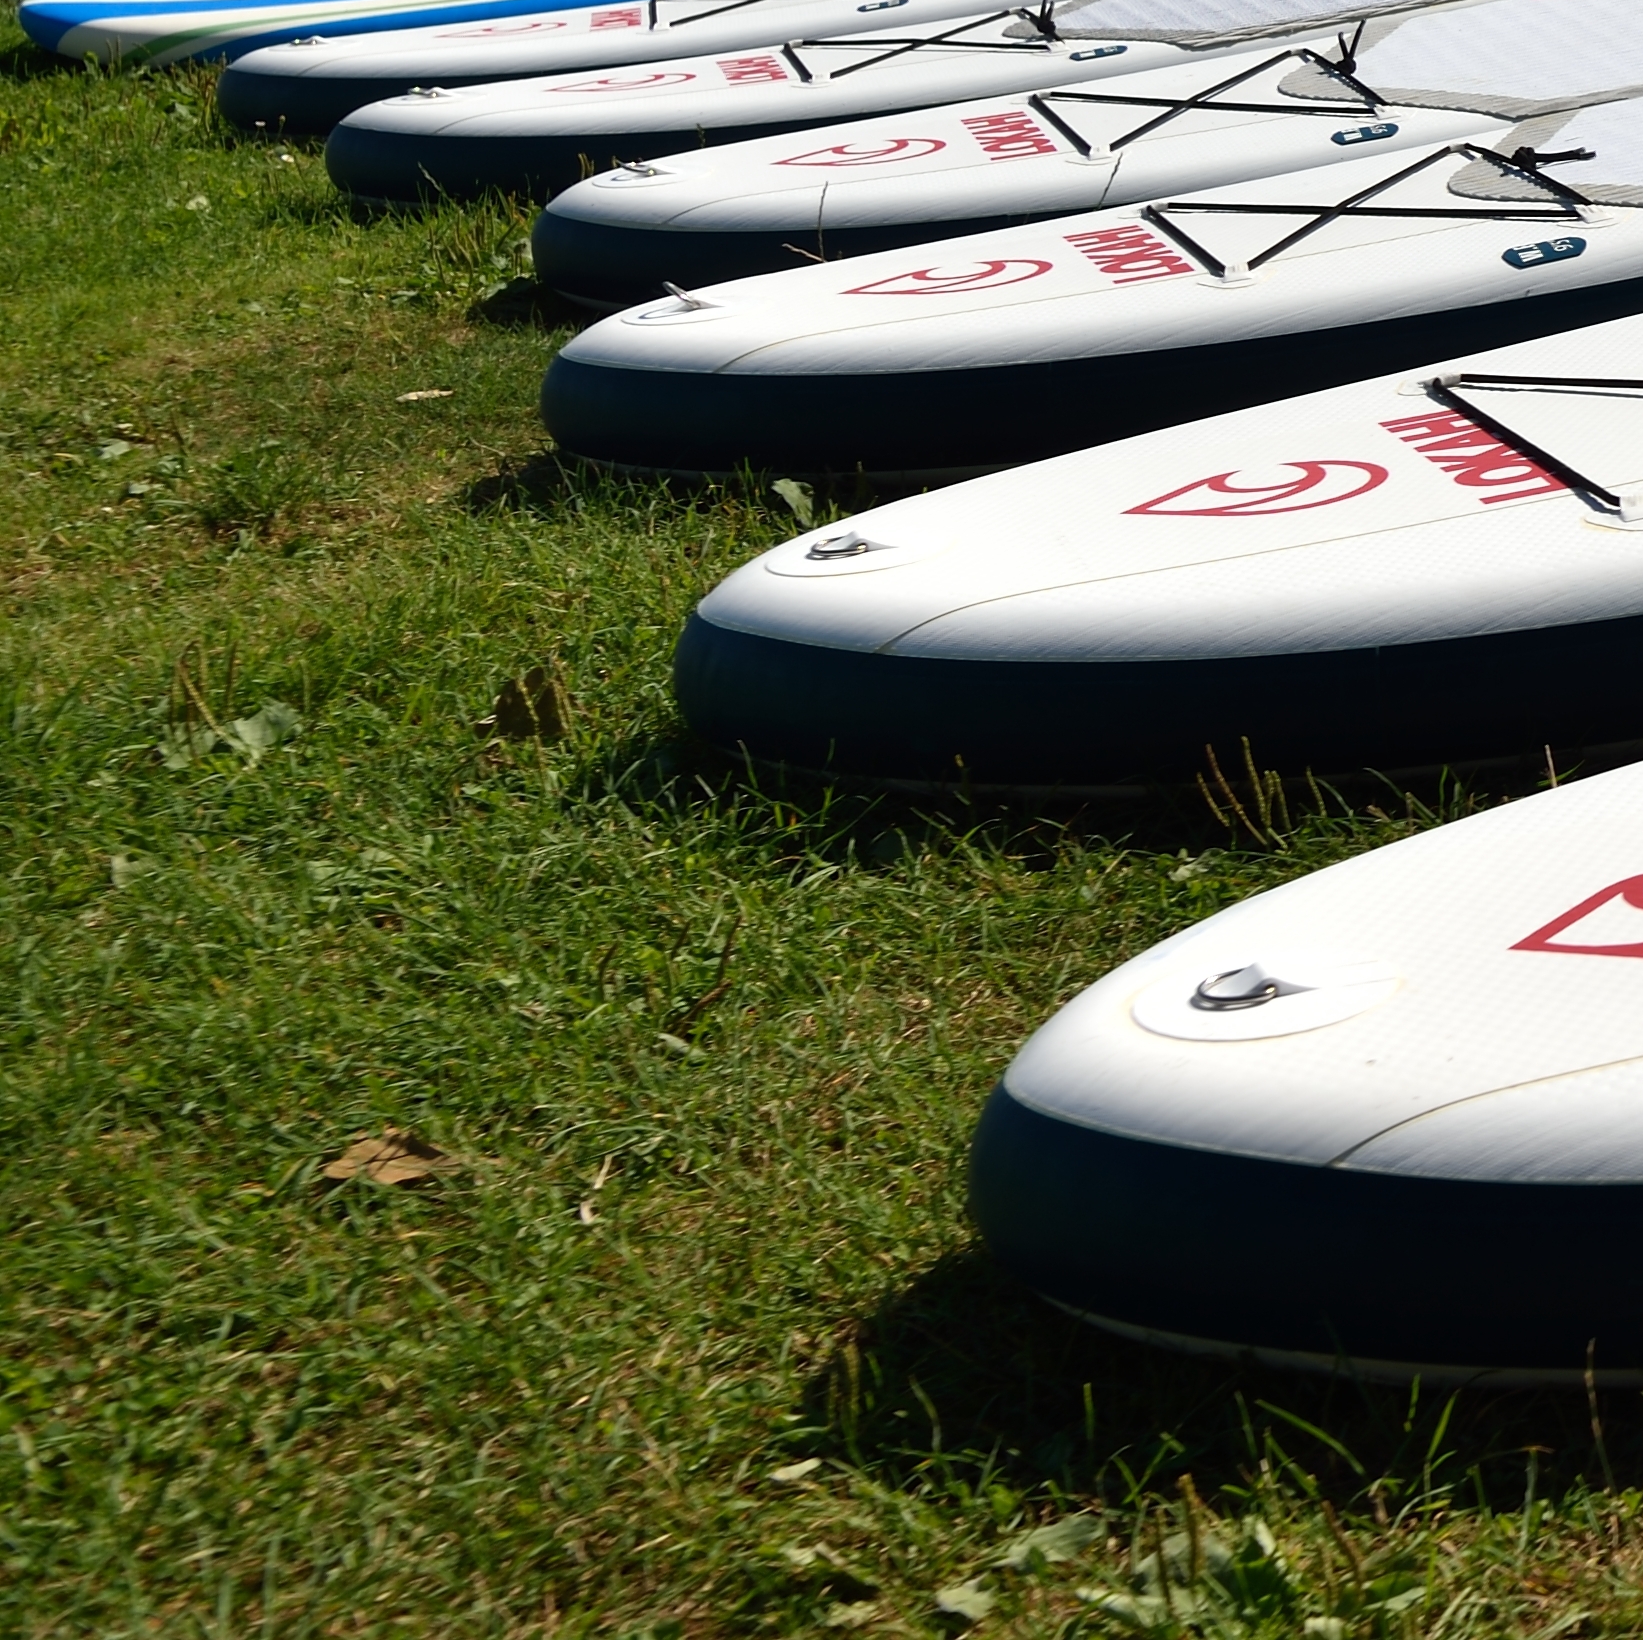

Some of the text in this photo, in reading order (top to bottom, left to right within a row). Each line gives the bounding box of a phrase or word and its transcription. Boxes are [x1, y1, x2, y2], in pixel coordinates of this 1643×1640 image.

[716, 55, 789, 87] LOKAHI
[960, 111, 1058, 161] LOKAHI
[1062, 225, 1195, 285] LOKAHI
[1377, 410, 1575, 505] LOKAHI
